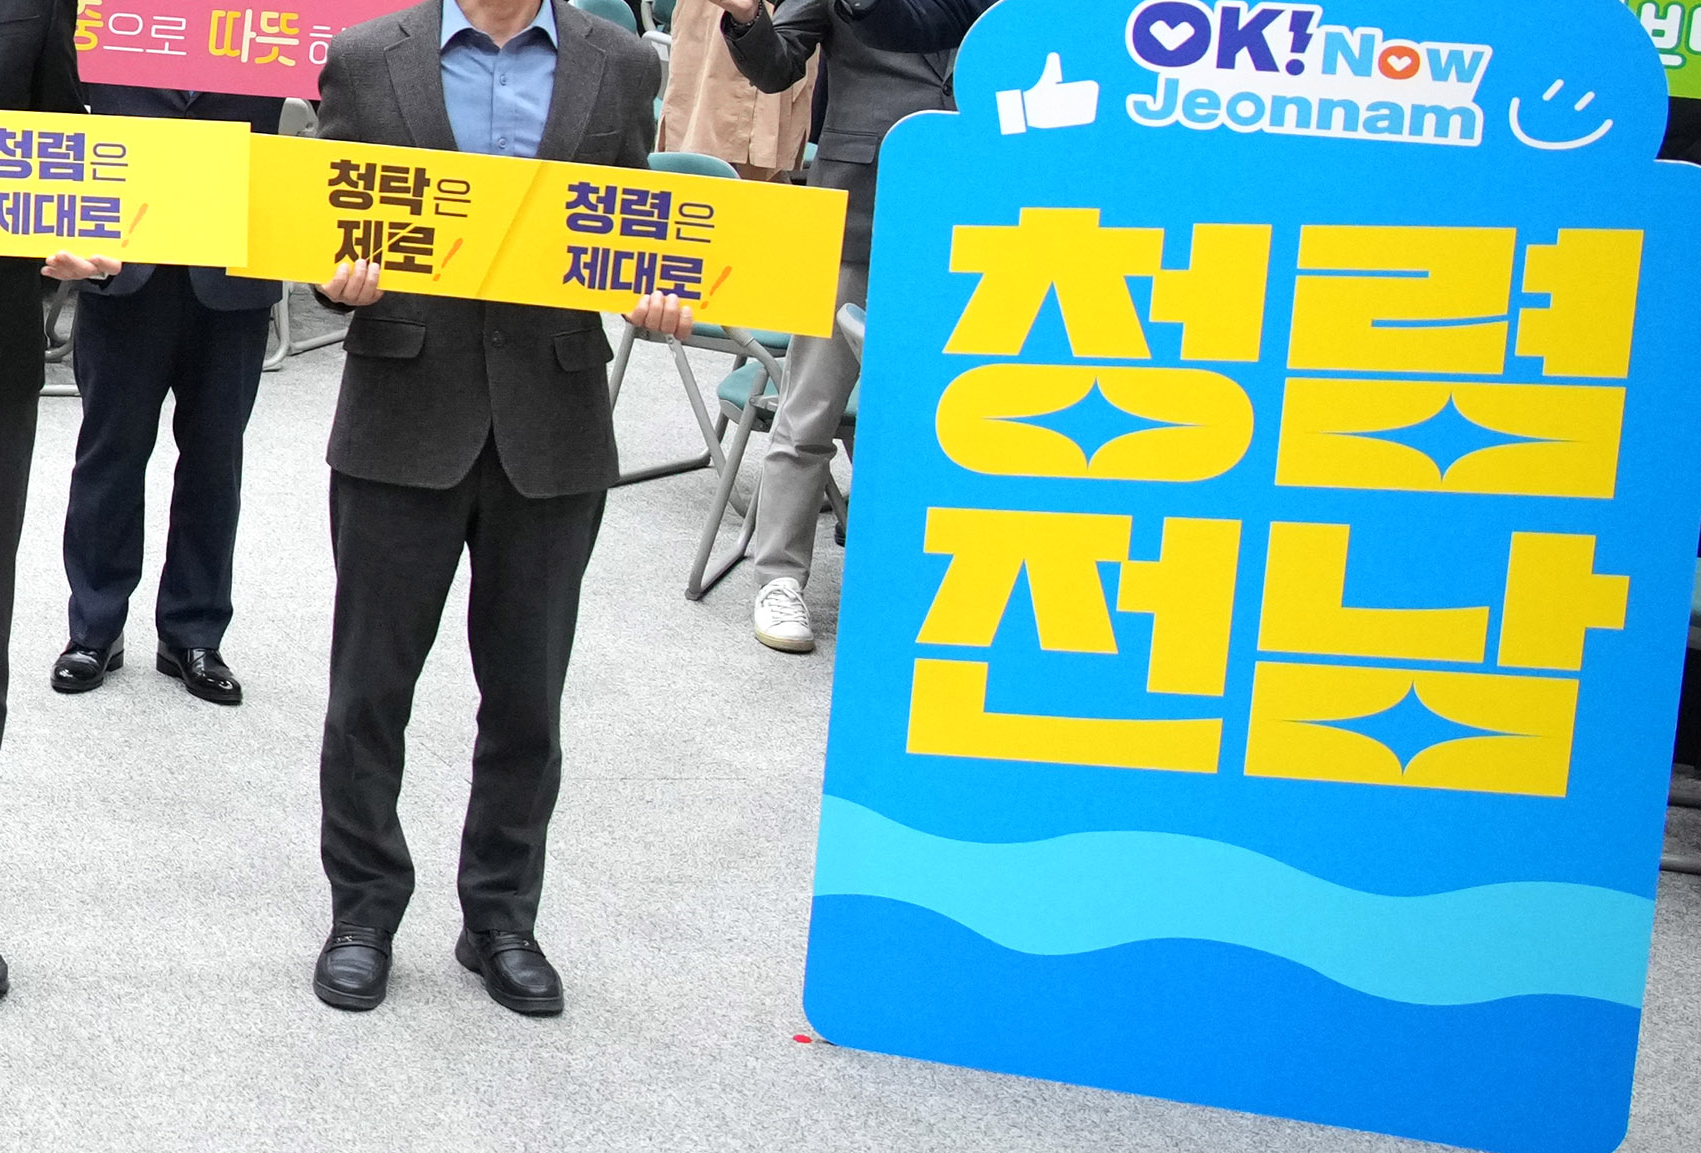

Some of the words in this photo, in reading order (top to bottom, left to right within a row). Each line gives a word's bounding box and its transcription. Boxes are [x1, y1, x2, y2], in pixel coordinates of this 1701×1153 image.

[1132, 1, 1315, 76] OK!
[1320, 31, 1485, 84] Now
[1132, 78, 1476, 141] Jeonnam
[327, 158, 472, 219] 청탁은
[564, 181, 716, 244] 청렴은
[334, 219, 464, 282] 제로!
[562, 245, 733, 310] 제대로!
[934, 206, 1645, 500] 청렴
[906, 505, 1631, 798] 전남
